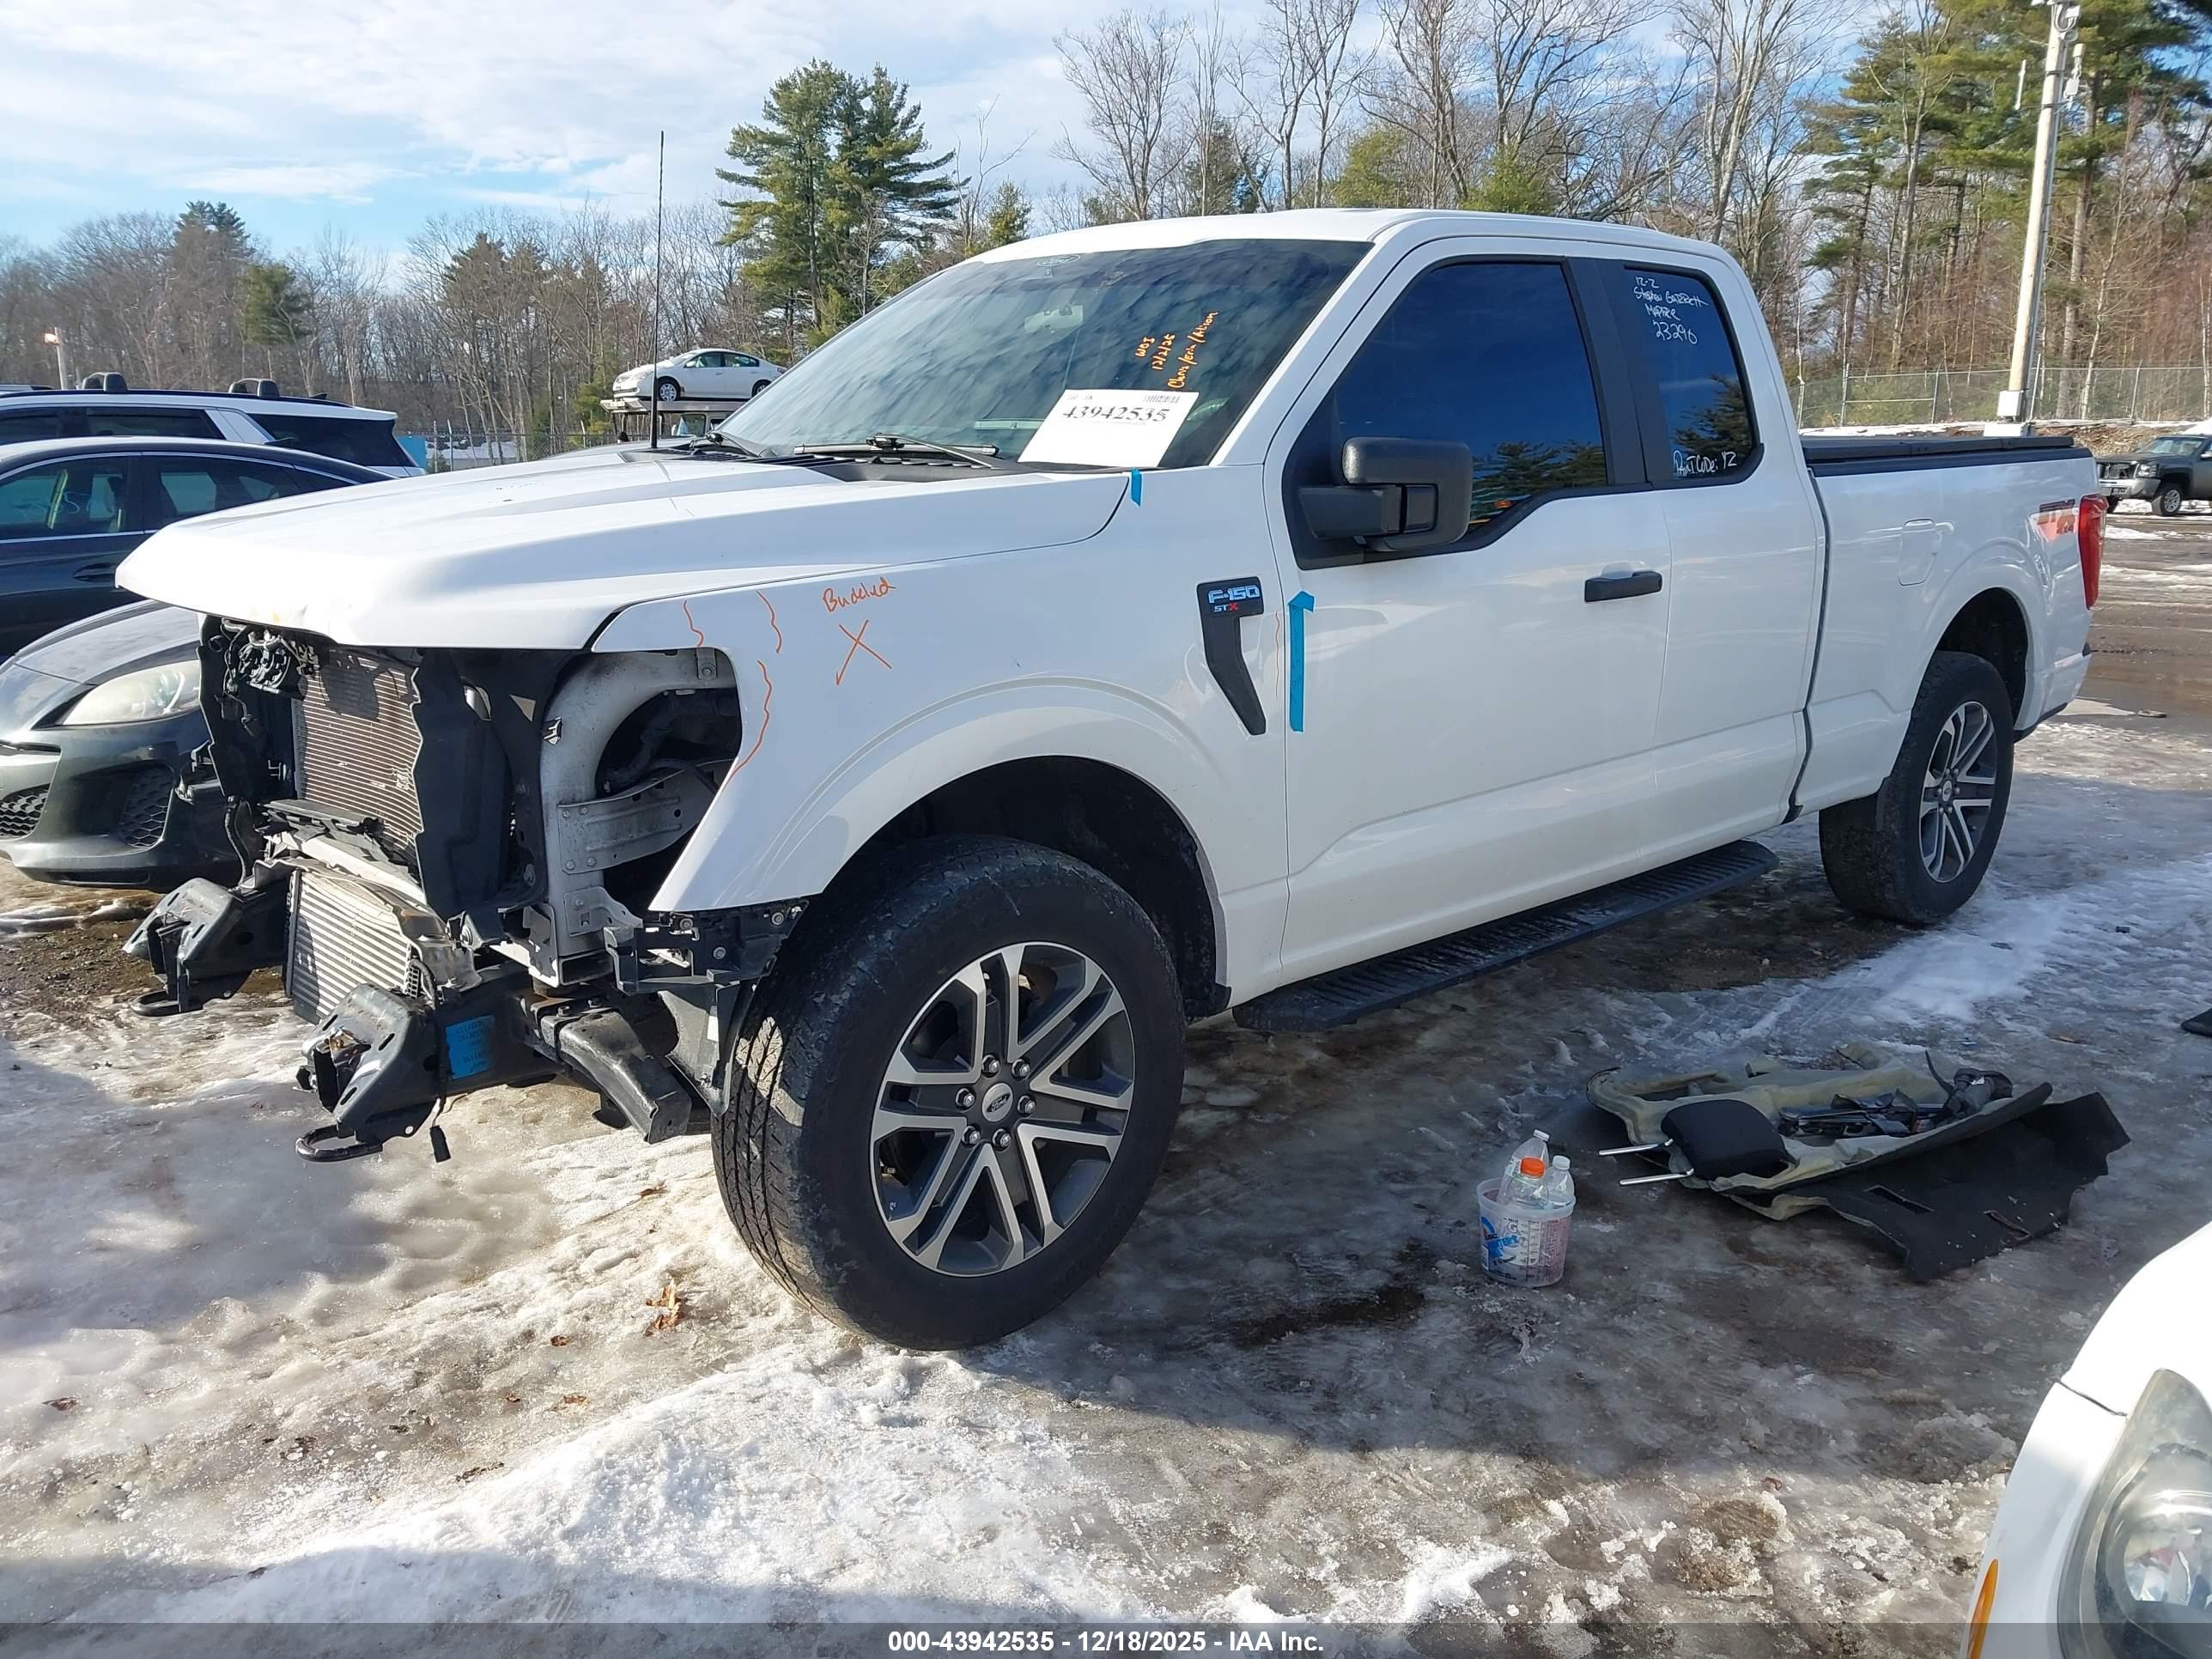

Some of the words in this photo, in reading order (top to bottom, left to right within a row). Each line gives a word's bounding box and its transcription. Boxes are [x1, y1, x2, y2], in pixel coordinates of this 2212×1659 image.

[1152, 332, 1176, 370] 12/2/25
[1063, 405, 1170, 422] 43942535
[1208, 585, 1260, 603] F-150
[1214, 603, 1239, 612] STX
